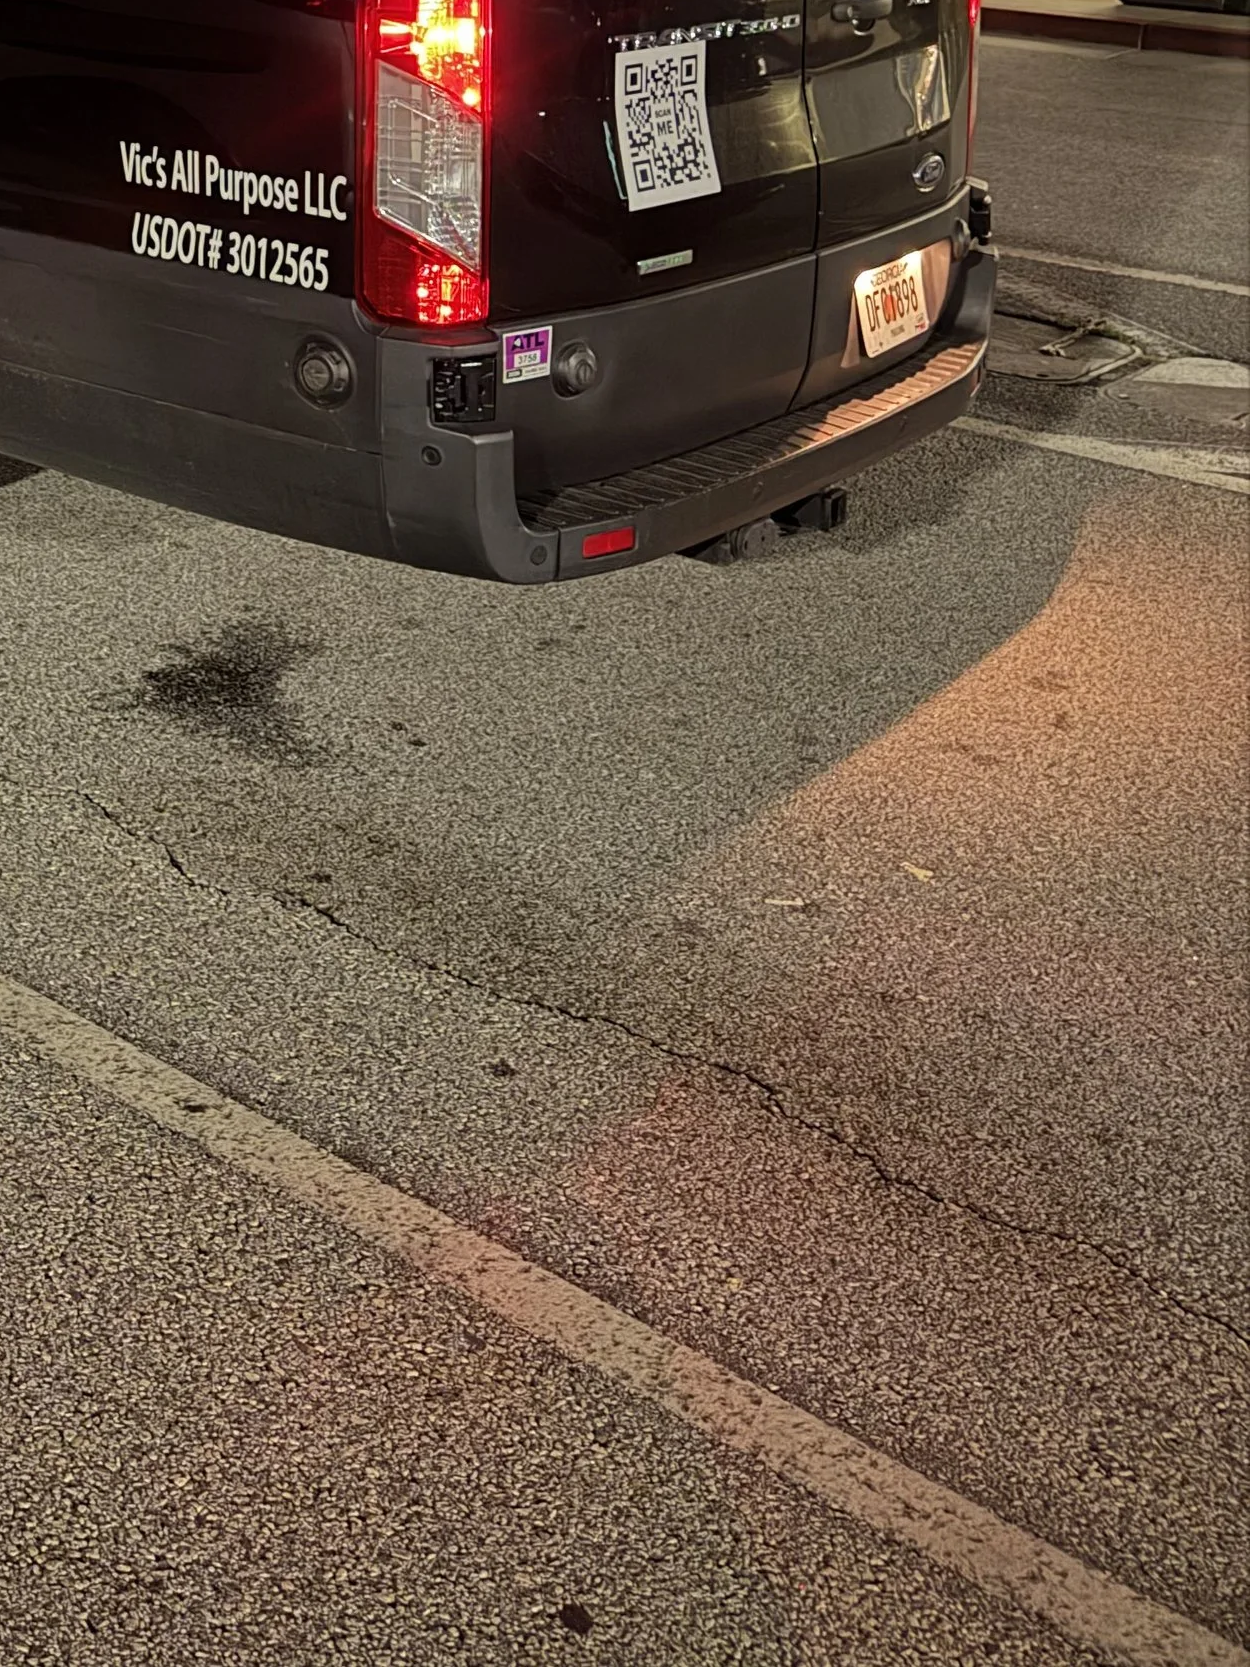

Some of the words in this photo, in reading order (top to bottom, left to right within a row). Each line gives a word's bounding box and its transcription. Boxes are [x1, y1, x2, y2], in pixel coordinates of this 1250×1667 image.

[654, 108, 672, 119] SCAN
[656, 119, 674, 136] ME
[119, 140, 167, 189] Vic's
[171, 149, 200, 194] All
[205, 154, 299, 215] Purpose
[304, 170, 348, 221] LLC
[131, 211, 223, 270] USDOT#
[226, 231, 329, 291] 3012565
[511, 331, 545, 351] ATL
